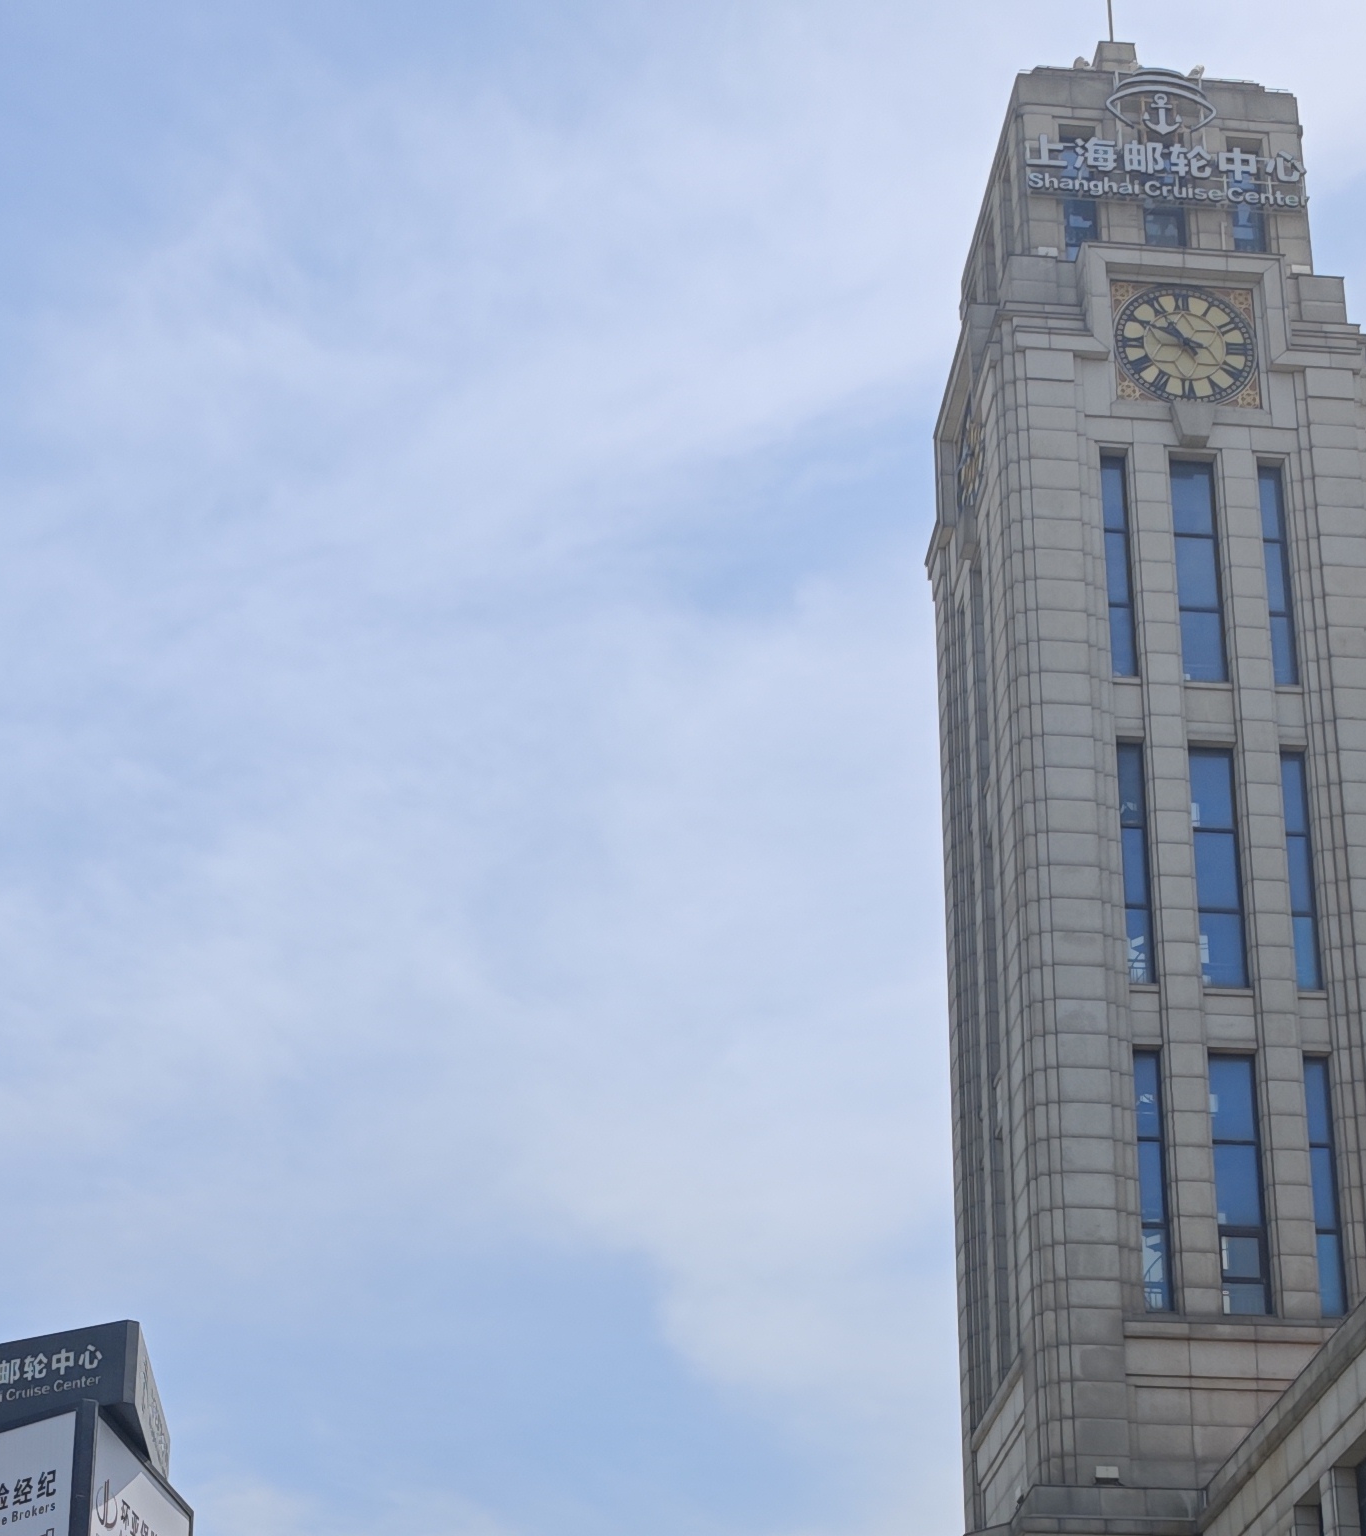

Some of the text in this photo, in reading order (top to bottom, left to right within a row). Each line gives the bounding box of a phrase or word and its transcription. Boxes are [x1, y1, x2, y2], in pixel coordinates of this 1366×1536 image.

[1026, 134, 1307, 183] 上海邮轮中心
[1027, 172, 1310, 208] Shanghai Cruise Center
[6, 1383, 50, 1402] Cruise
[53, 1375, 101, 1394] Center
[11, 1501, 56, 1524] Brokers
